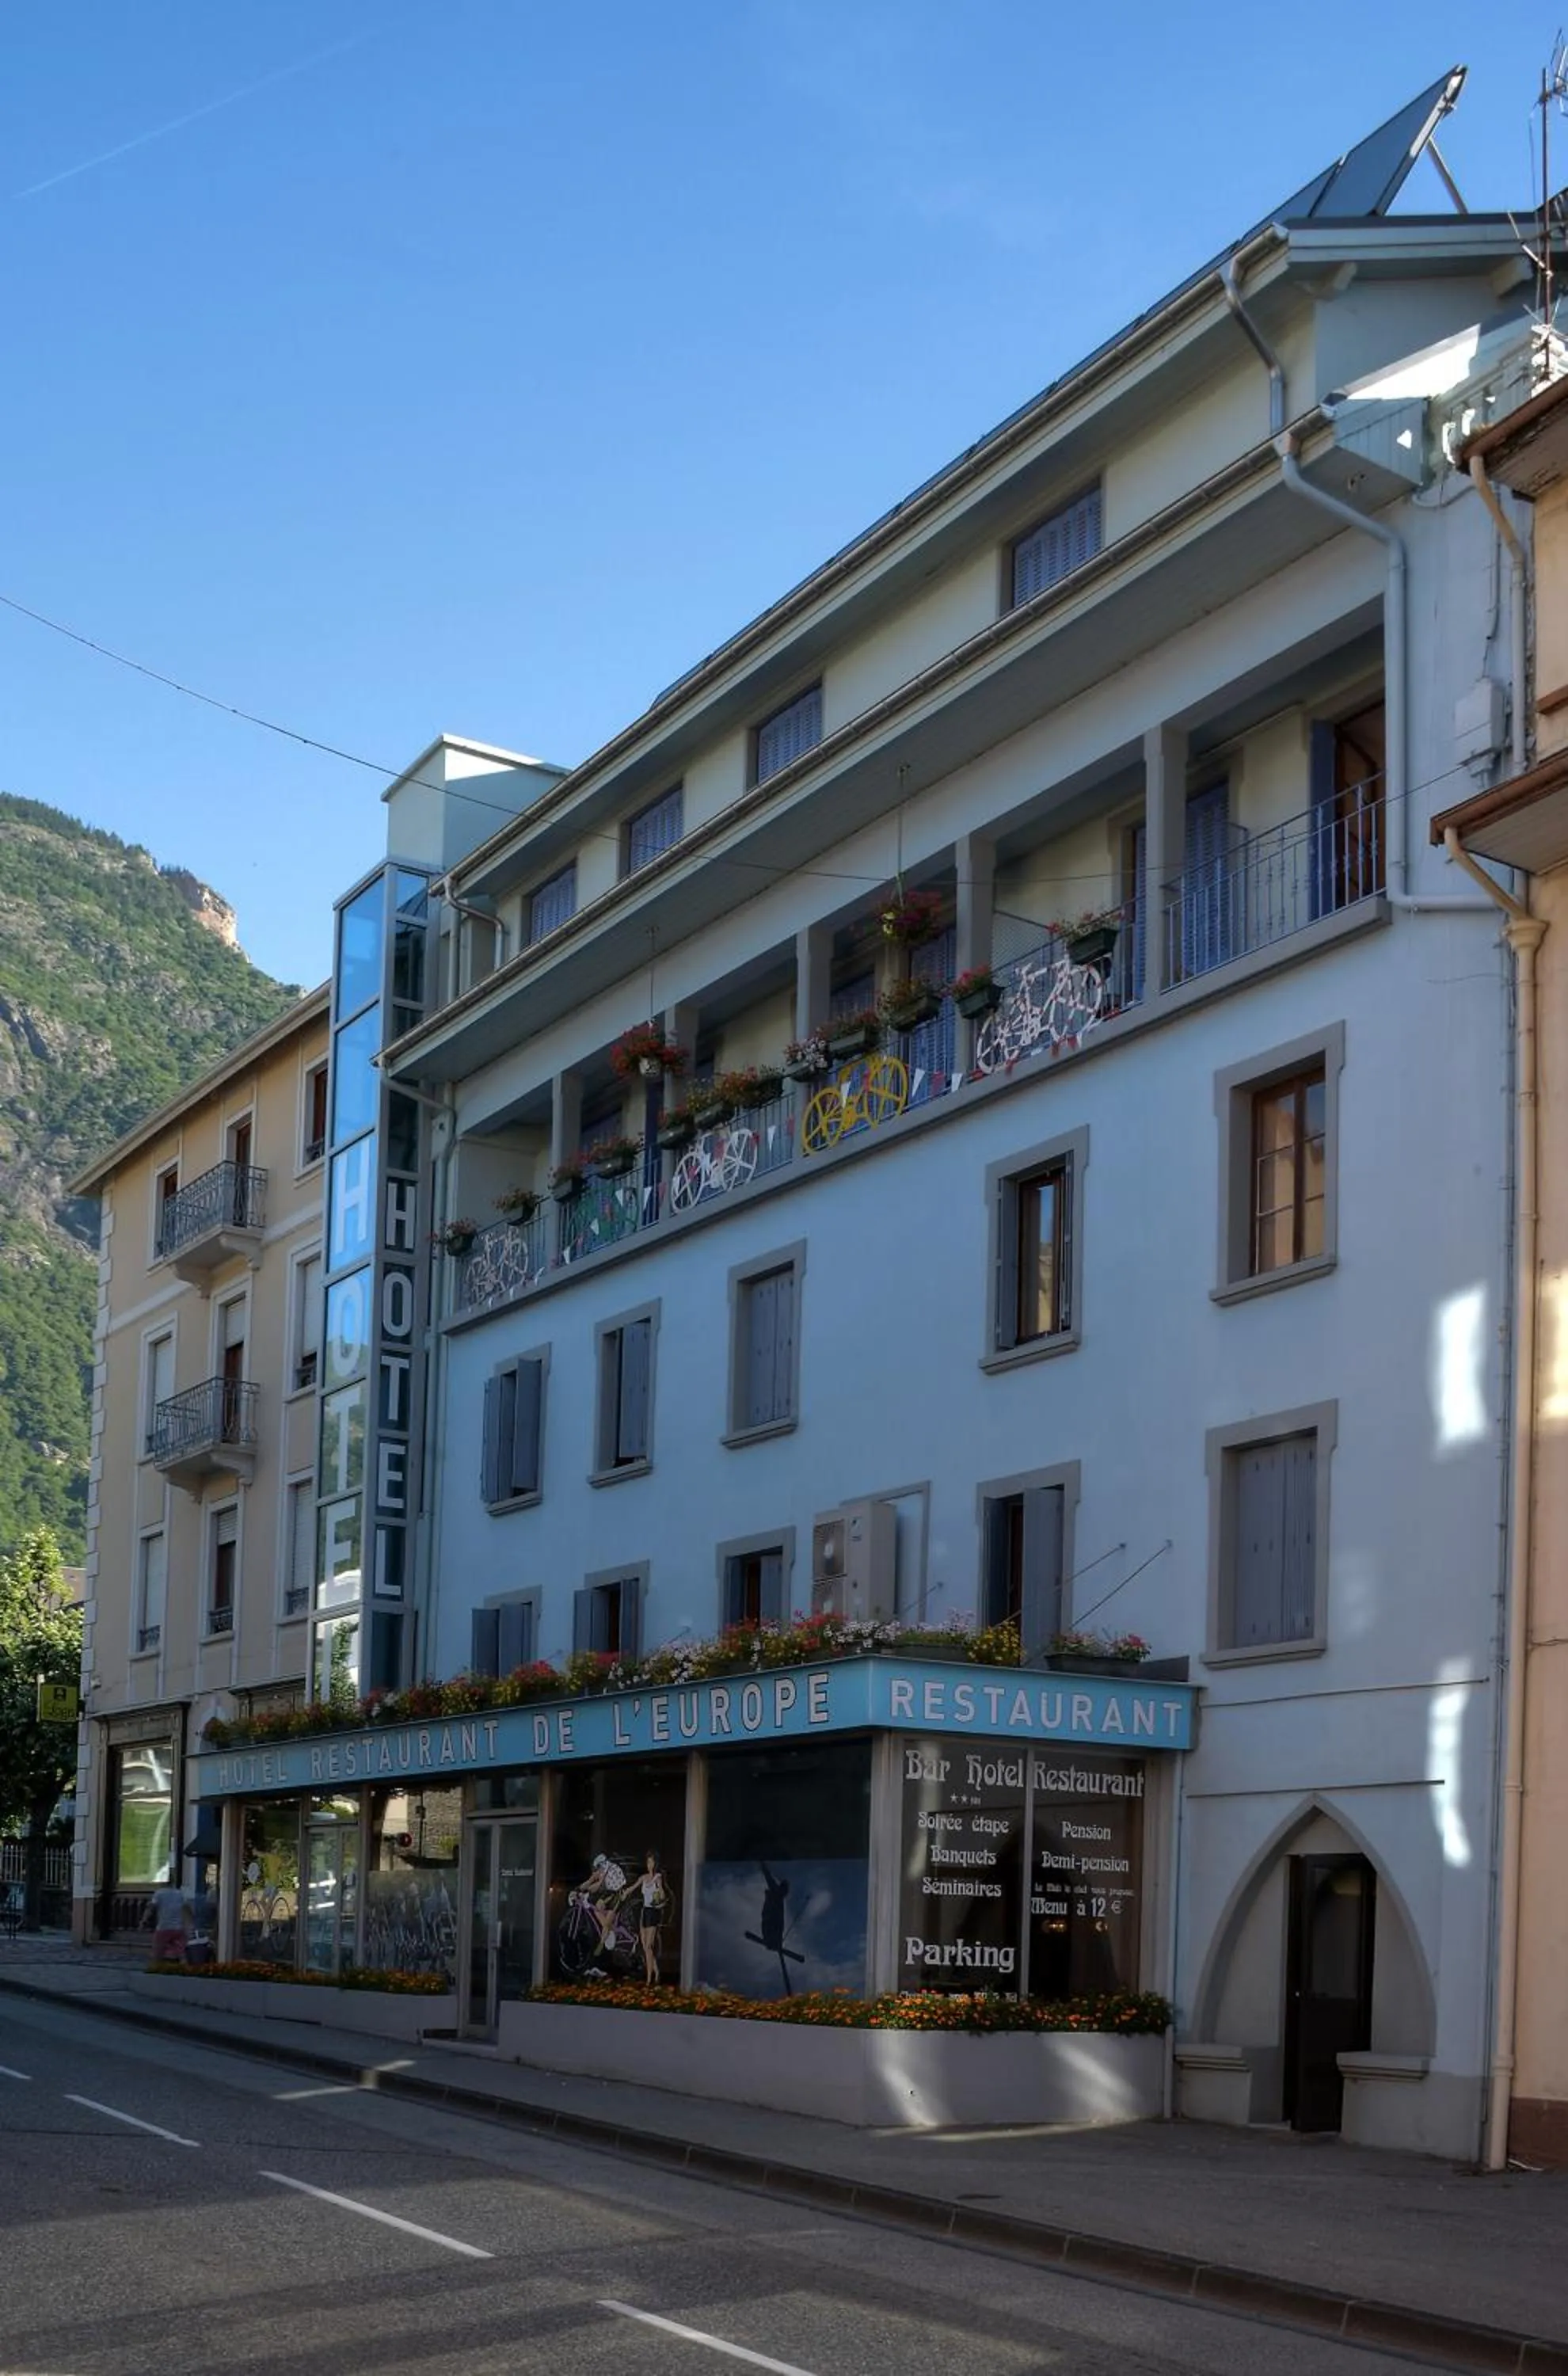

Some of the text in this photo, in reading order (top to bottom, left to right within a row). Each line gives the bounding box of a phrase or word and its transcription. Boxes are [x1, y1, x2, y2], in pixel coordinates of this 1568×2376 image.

[375, 1181, 415, 1596] HOTEL
[890, 1678, 1183, 1738] RESTAURANT
[219, 1672, 829, 1789] HOTEL RESTAURANT DE L'EUROPE
[905, 1750, 1144, 1797] Bar Hotel Restaurant
[918, 1811, 1010, 1837] Soirée étape
[1062, 1821, 1111, 1840] Pension
[931, 1845, 997, 1868] Banquets
[1041, 1851, 1129, 1874] Demi-pension
[922, 1876, 1002, 1897] Séminaires
[1030, 1897, 1068, 1915] Menu
[1076, 1900, 1087, 1917] à
[1090, 1897, 1106, 1917] 12
[905, 1936, 1015, 1974] Parking
